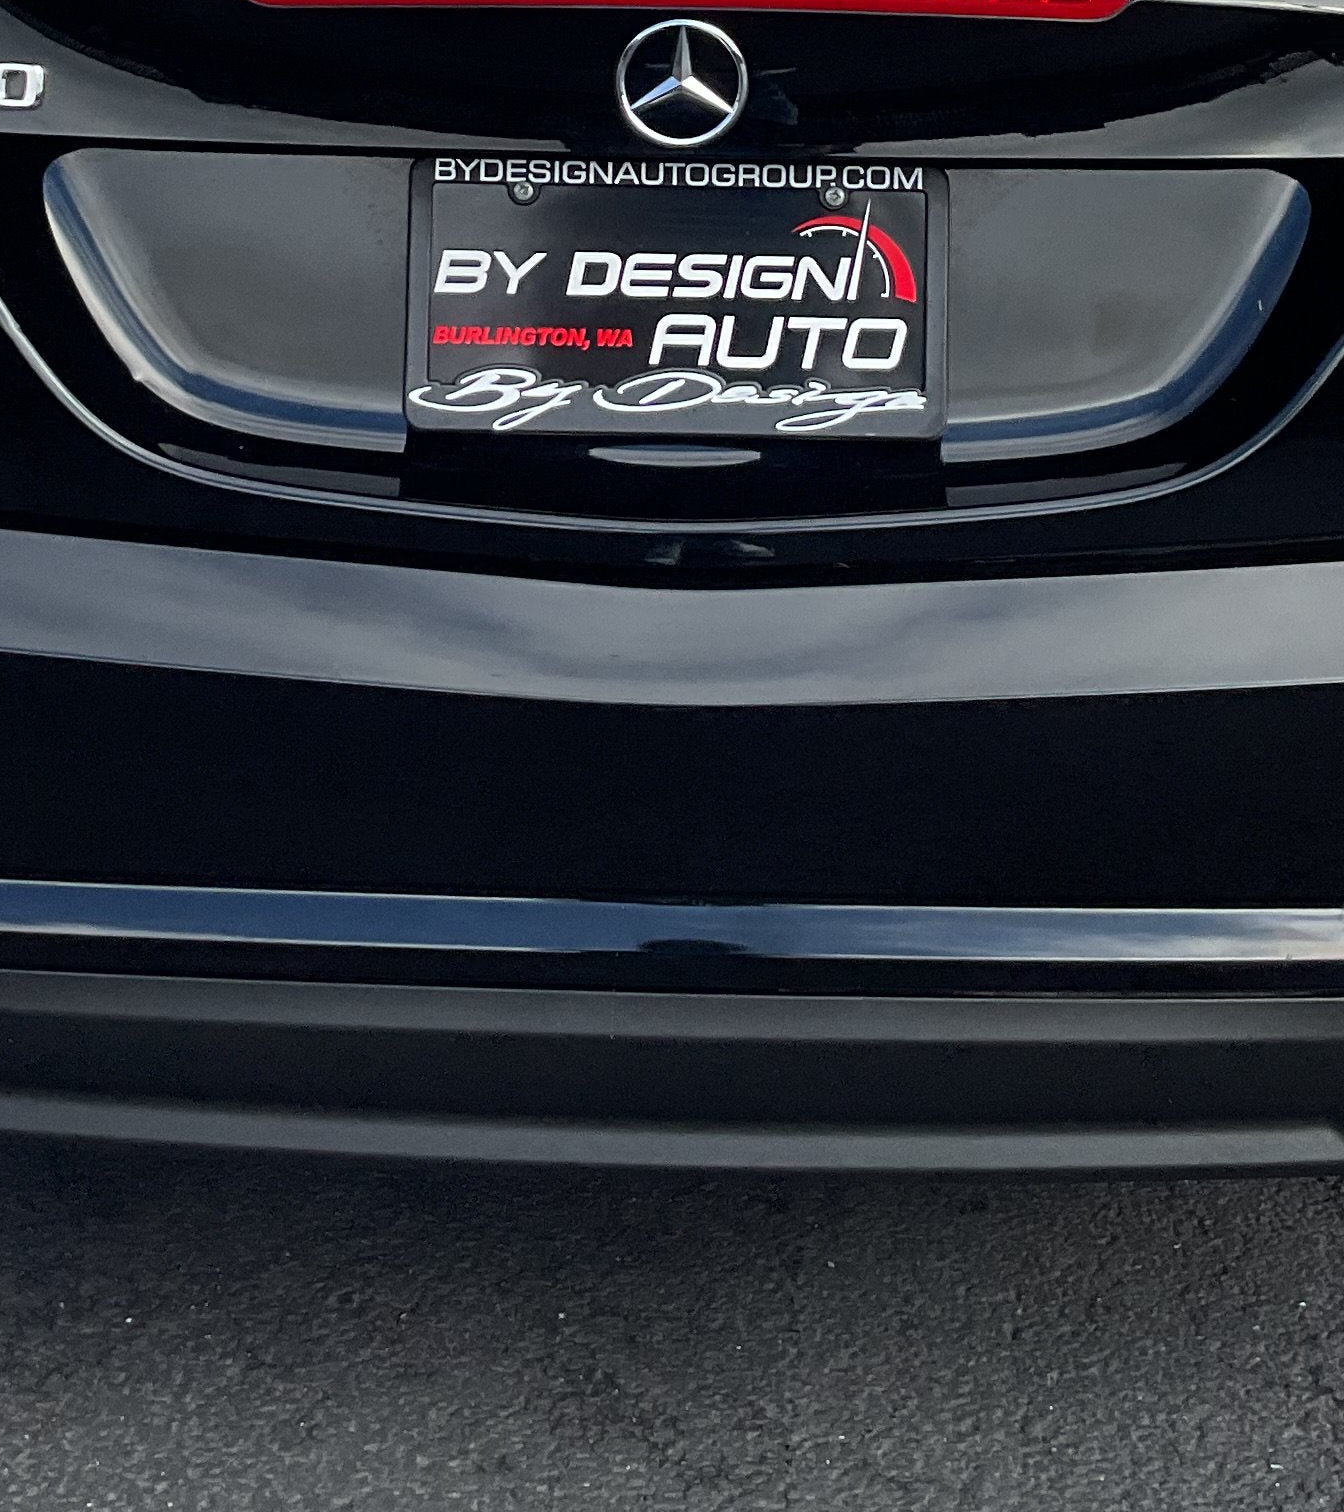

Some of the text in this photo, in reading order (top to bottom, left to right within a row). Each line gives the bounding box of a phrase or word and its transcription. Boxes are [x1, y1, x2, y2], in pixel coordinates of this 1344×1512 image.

[434, 158, 924, 191] BYDESIGNAUTOGROUP.COM
[433, 249, 858, 302] BY DESIGN
[432, 325, 634, 351] BURLINGTON, WA
[648, 313, 908, 371] AUTO
[408, 368, 929, 434] By Design
